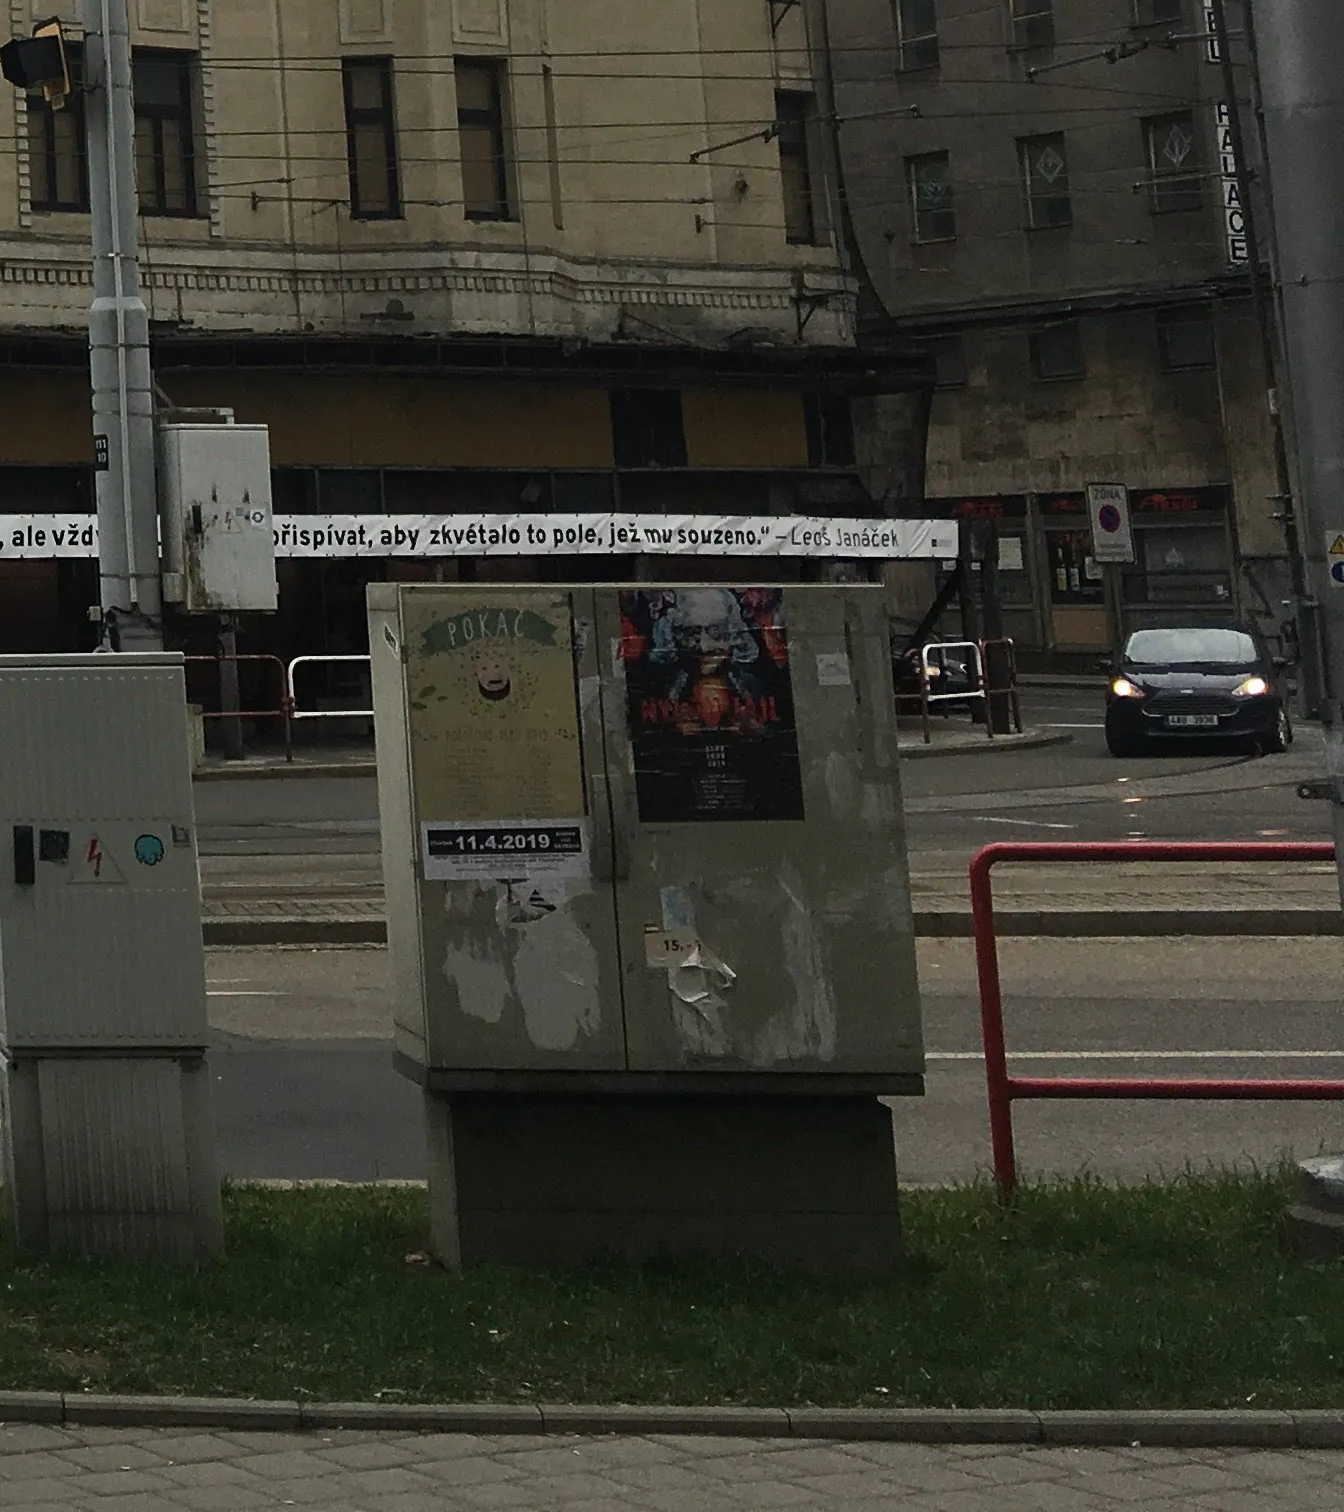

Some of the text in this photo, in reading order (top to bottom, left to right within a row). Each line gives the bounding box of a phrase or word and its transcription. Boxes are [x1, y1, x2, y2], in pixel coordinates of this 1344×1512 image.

[11, 524, 47, 547] ale
[380, 523, 420, 551] aby
[429, 522, 521, 546] zkvétalo
[526, 523, 547, 545] to
[552, 523, 603, 549] pole,
[608, 522, 642, 549] jež
[644, 527, 673, 544] mu
[791, 525, 831, 546] Leoš
[835, 527, 900, 548] Janáček
[456, 834, 551, 851] 11.4.2019
